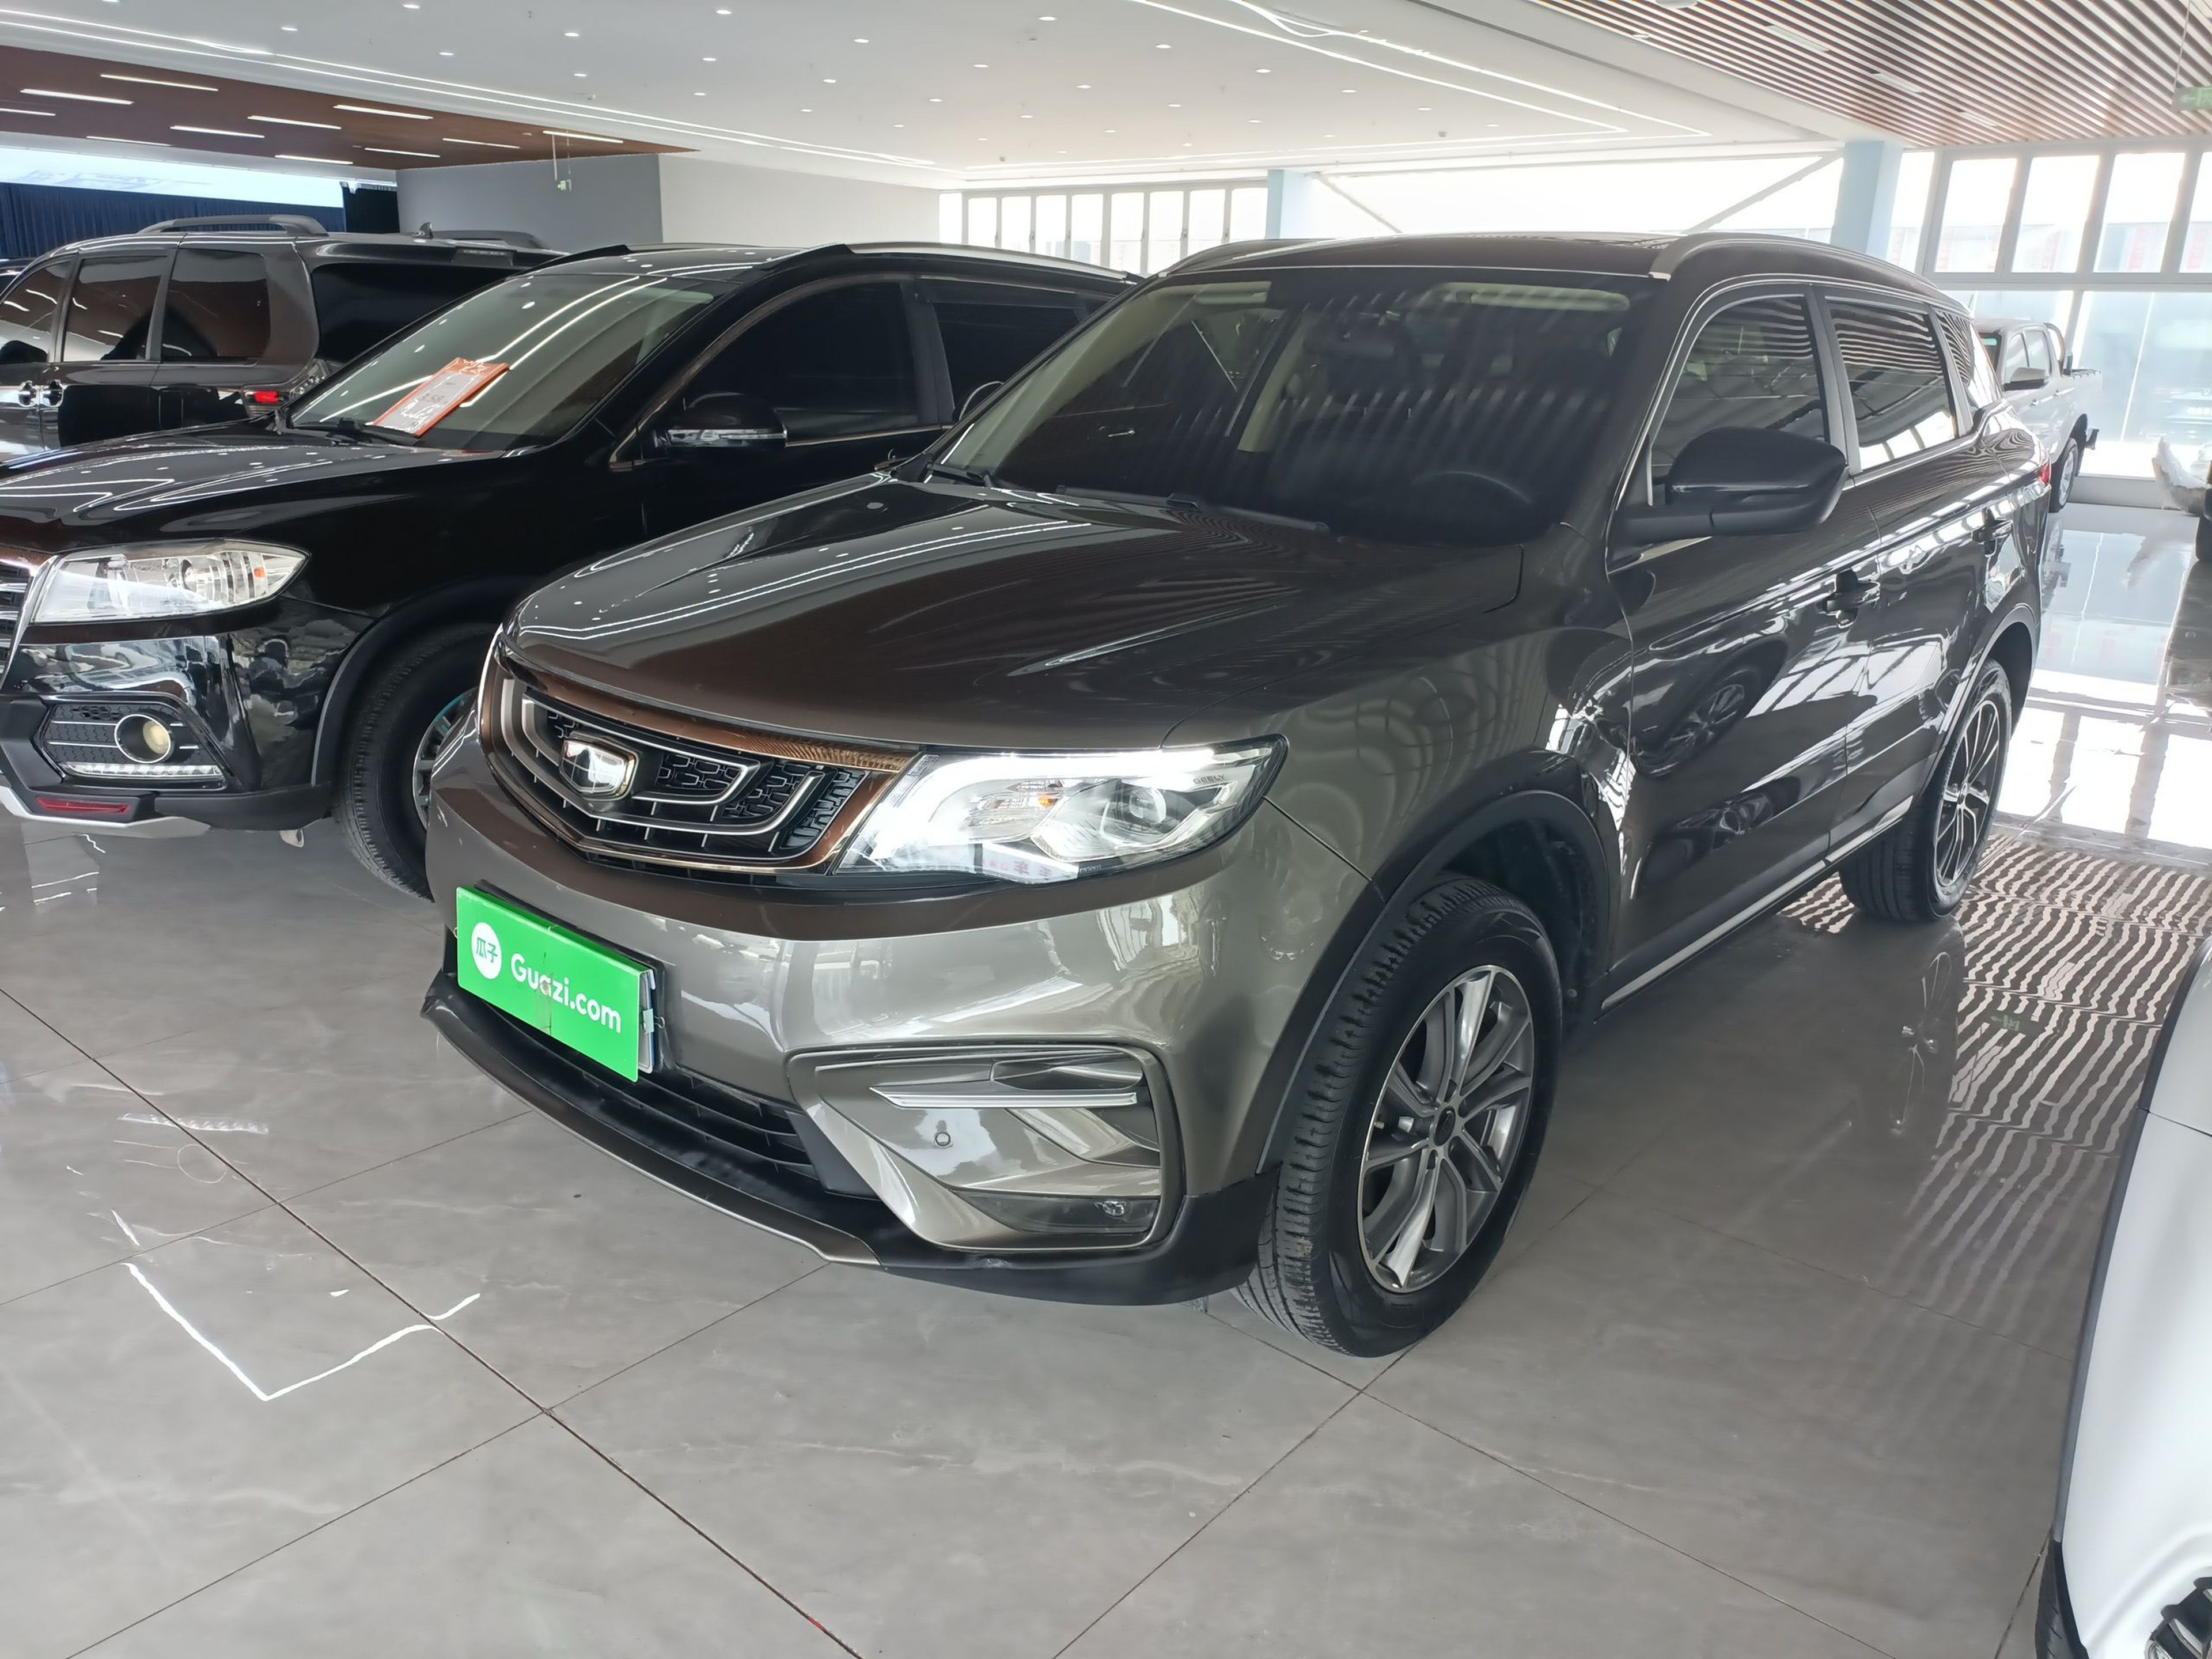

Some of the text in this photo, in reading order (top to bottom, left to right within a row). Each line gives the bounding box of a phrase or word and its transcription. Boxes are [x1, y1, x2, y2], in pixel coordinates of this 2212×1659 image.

[1193, 774, 1225, 784] GEELY
[476, 937, 498, 963] 瓜子
[511, 953, 622, 1033] Guazi.com
